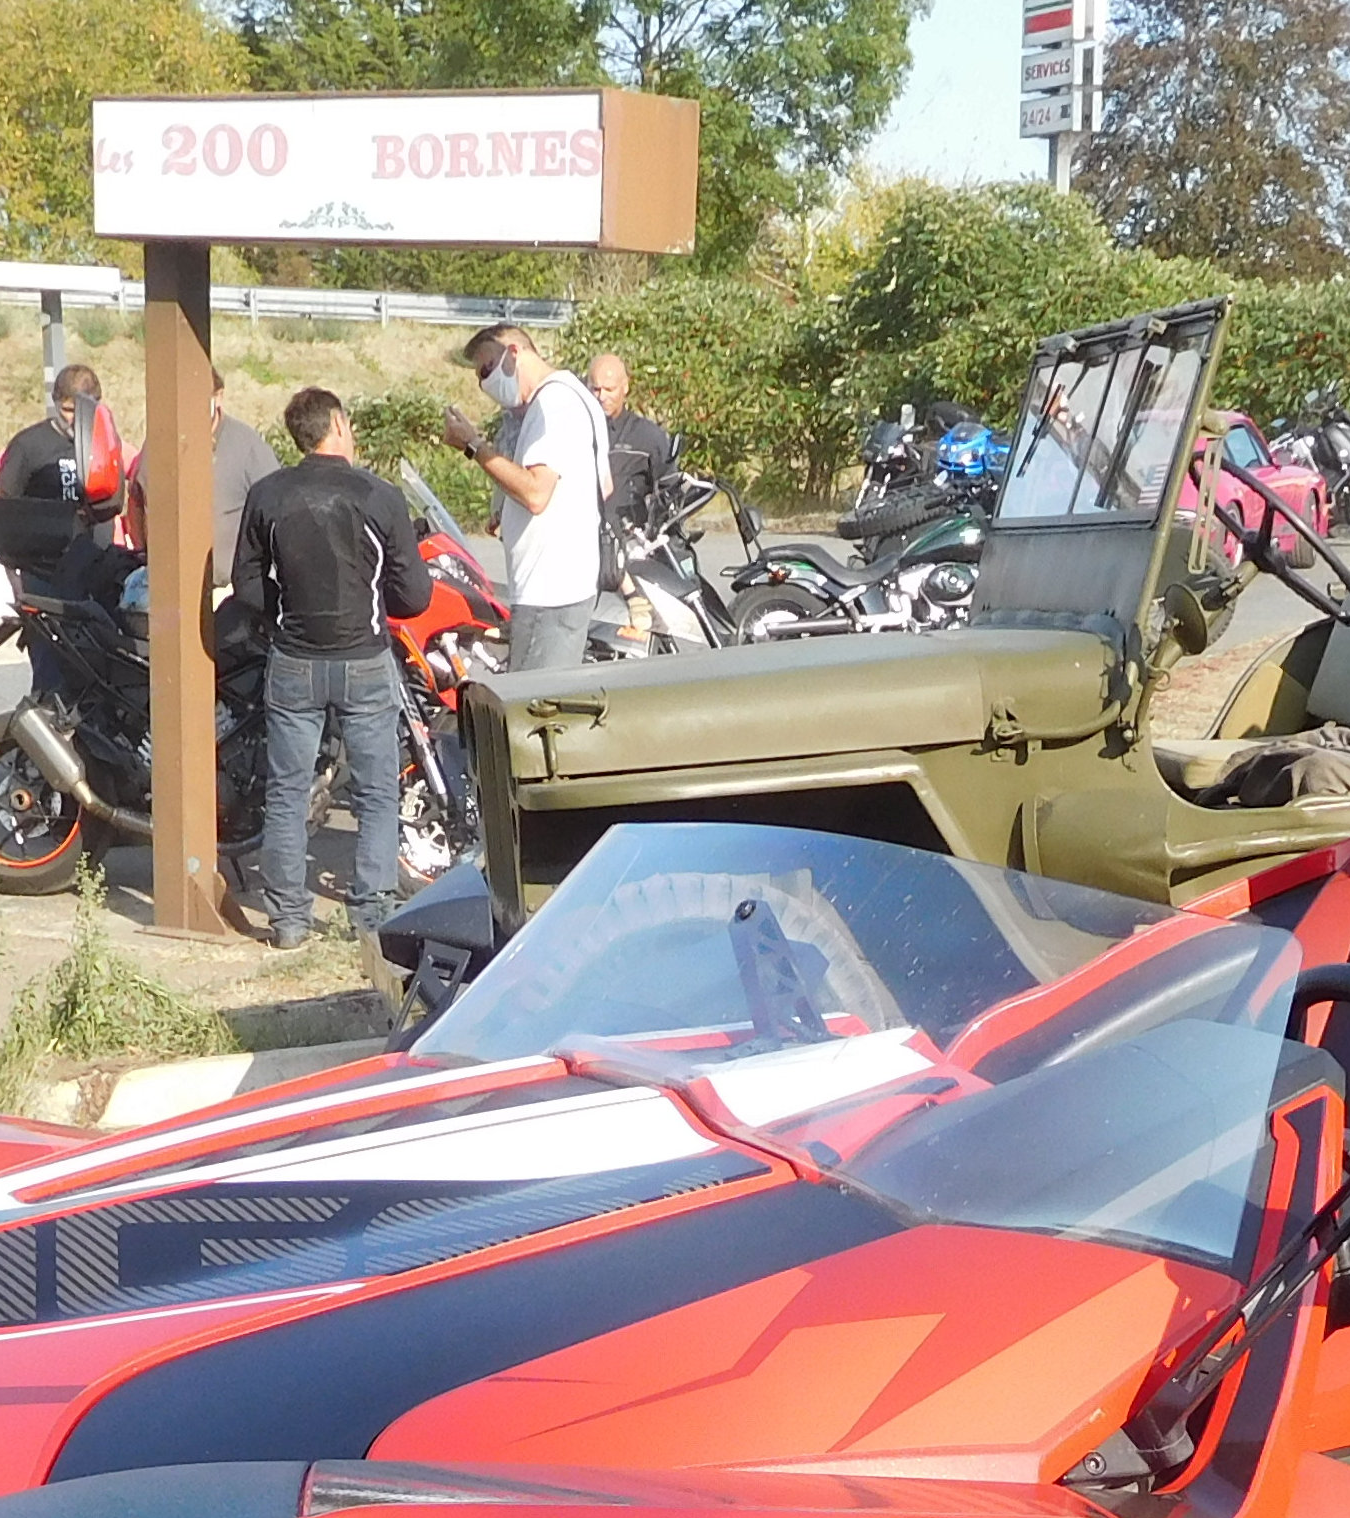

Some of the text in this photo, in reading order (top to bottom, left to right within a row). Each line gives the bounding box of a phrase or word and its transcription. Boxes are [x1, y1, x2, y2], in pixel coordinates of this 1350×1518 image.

[1024, 58, 1071, 82] SERVICES
[160, 122, 289, 177] 200
[371, 128, 601, 180] BORNES
